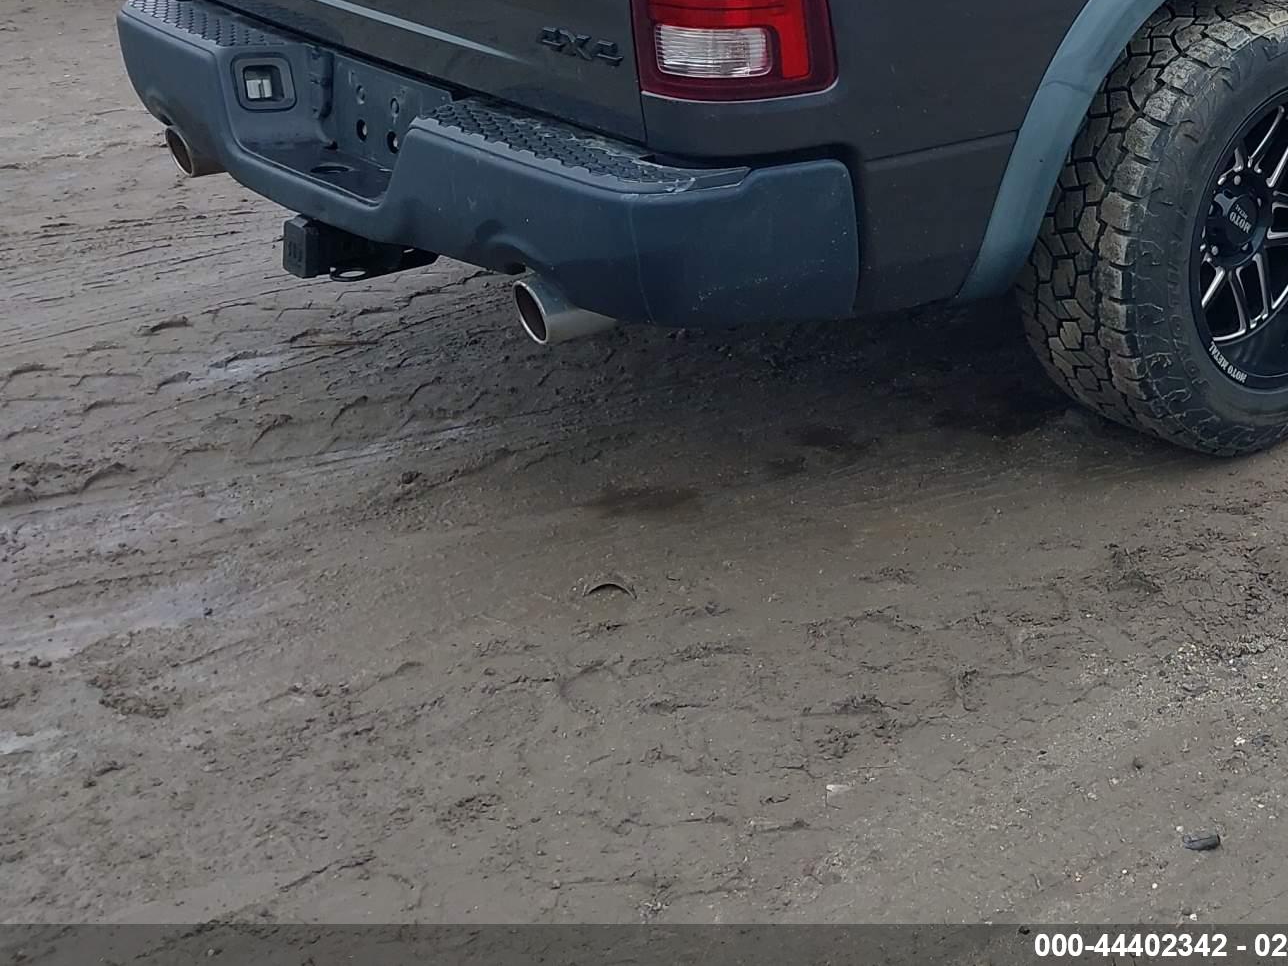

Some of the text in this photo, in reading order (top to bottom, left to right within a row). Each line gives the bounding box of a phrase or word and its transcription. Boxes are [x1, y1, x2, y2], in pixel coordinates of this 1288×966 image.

[1229, 211, 1252, 234] MOTO
[1208, 340, 1248, 384] MOTO METAL
